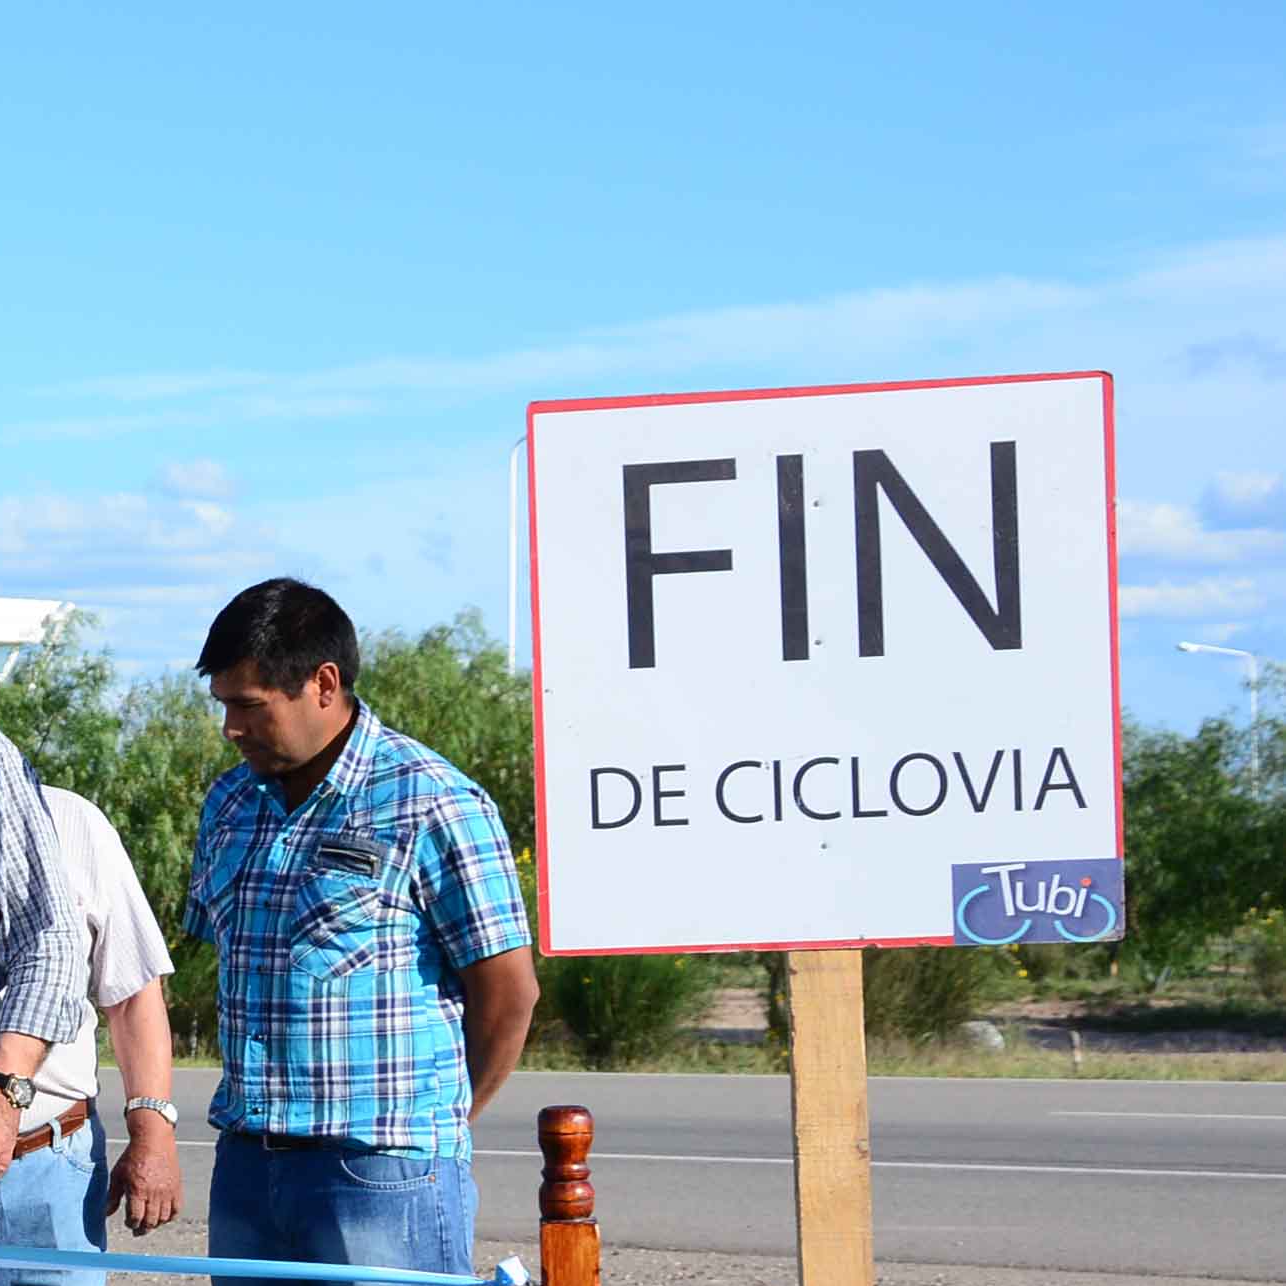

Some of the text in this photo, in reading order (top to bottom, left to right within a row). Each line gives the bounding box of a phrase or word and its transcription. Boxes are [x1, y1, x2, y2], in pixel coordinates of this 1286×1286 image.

[622, 440, 1023, 669] FIN
[590, 747, 1088, 830] DE CICLOVIA
[981, 863, 1092, 918] Tubi
